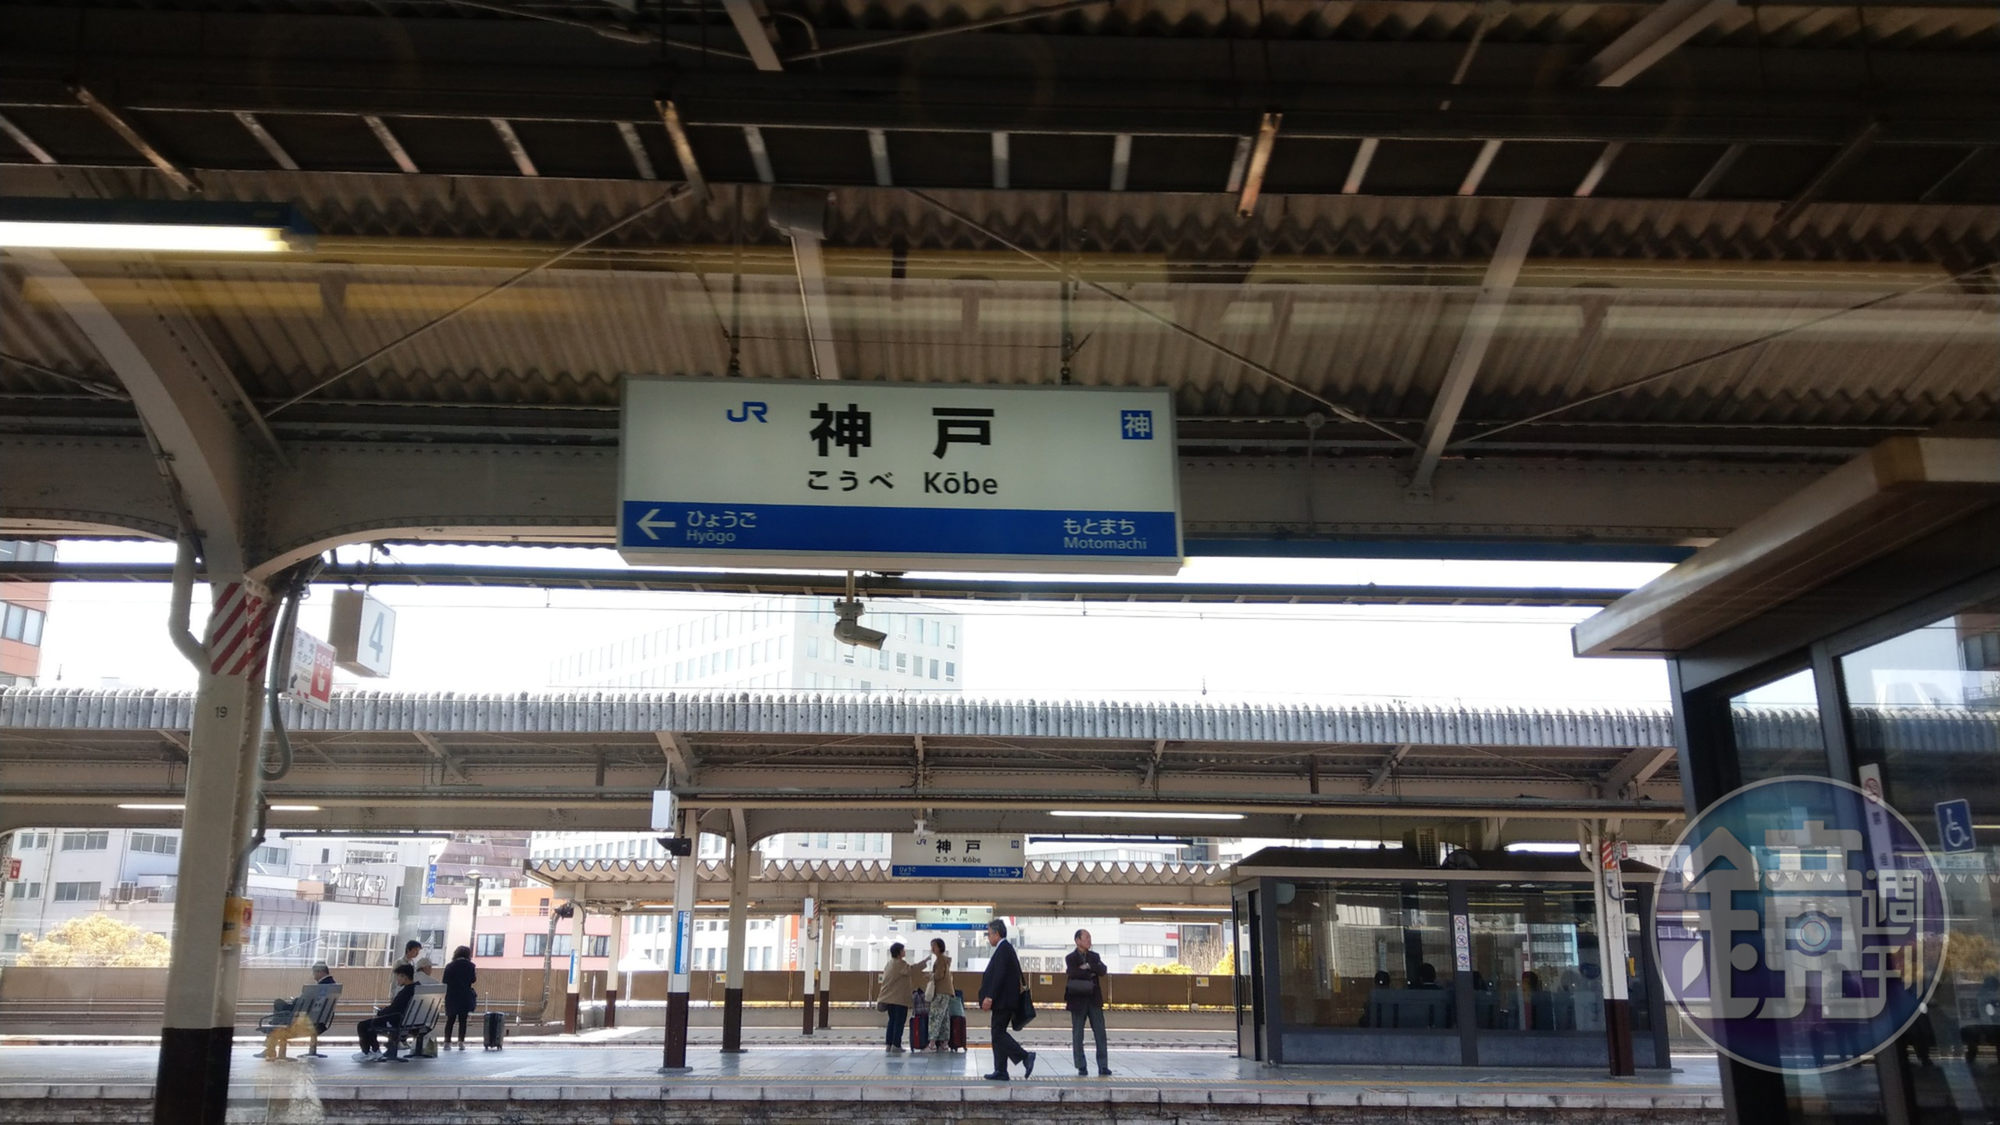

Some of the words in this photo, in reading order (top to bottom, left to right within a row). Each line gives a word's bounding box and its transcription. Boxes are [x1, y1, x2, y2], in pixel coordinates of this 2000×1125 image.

[726, 401, 768, 423] JR
[809, 402, 995, 460] 神戸
[1123, 412, 1151, 438] 神
[807, 470, 895, 492] こうべ
[687, 510, 757, 528] ひょうご
[1063, 518, 1136, 536] もとまち
[1063, 536, 1147, 550] Motomachi
[368, 611, 385, 663] 4
[315, 652, 332, 670] SOS
[215, 706, 228, 718] 19
[936, 839, 981, 854] 神戸
